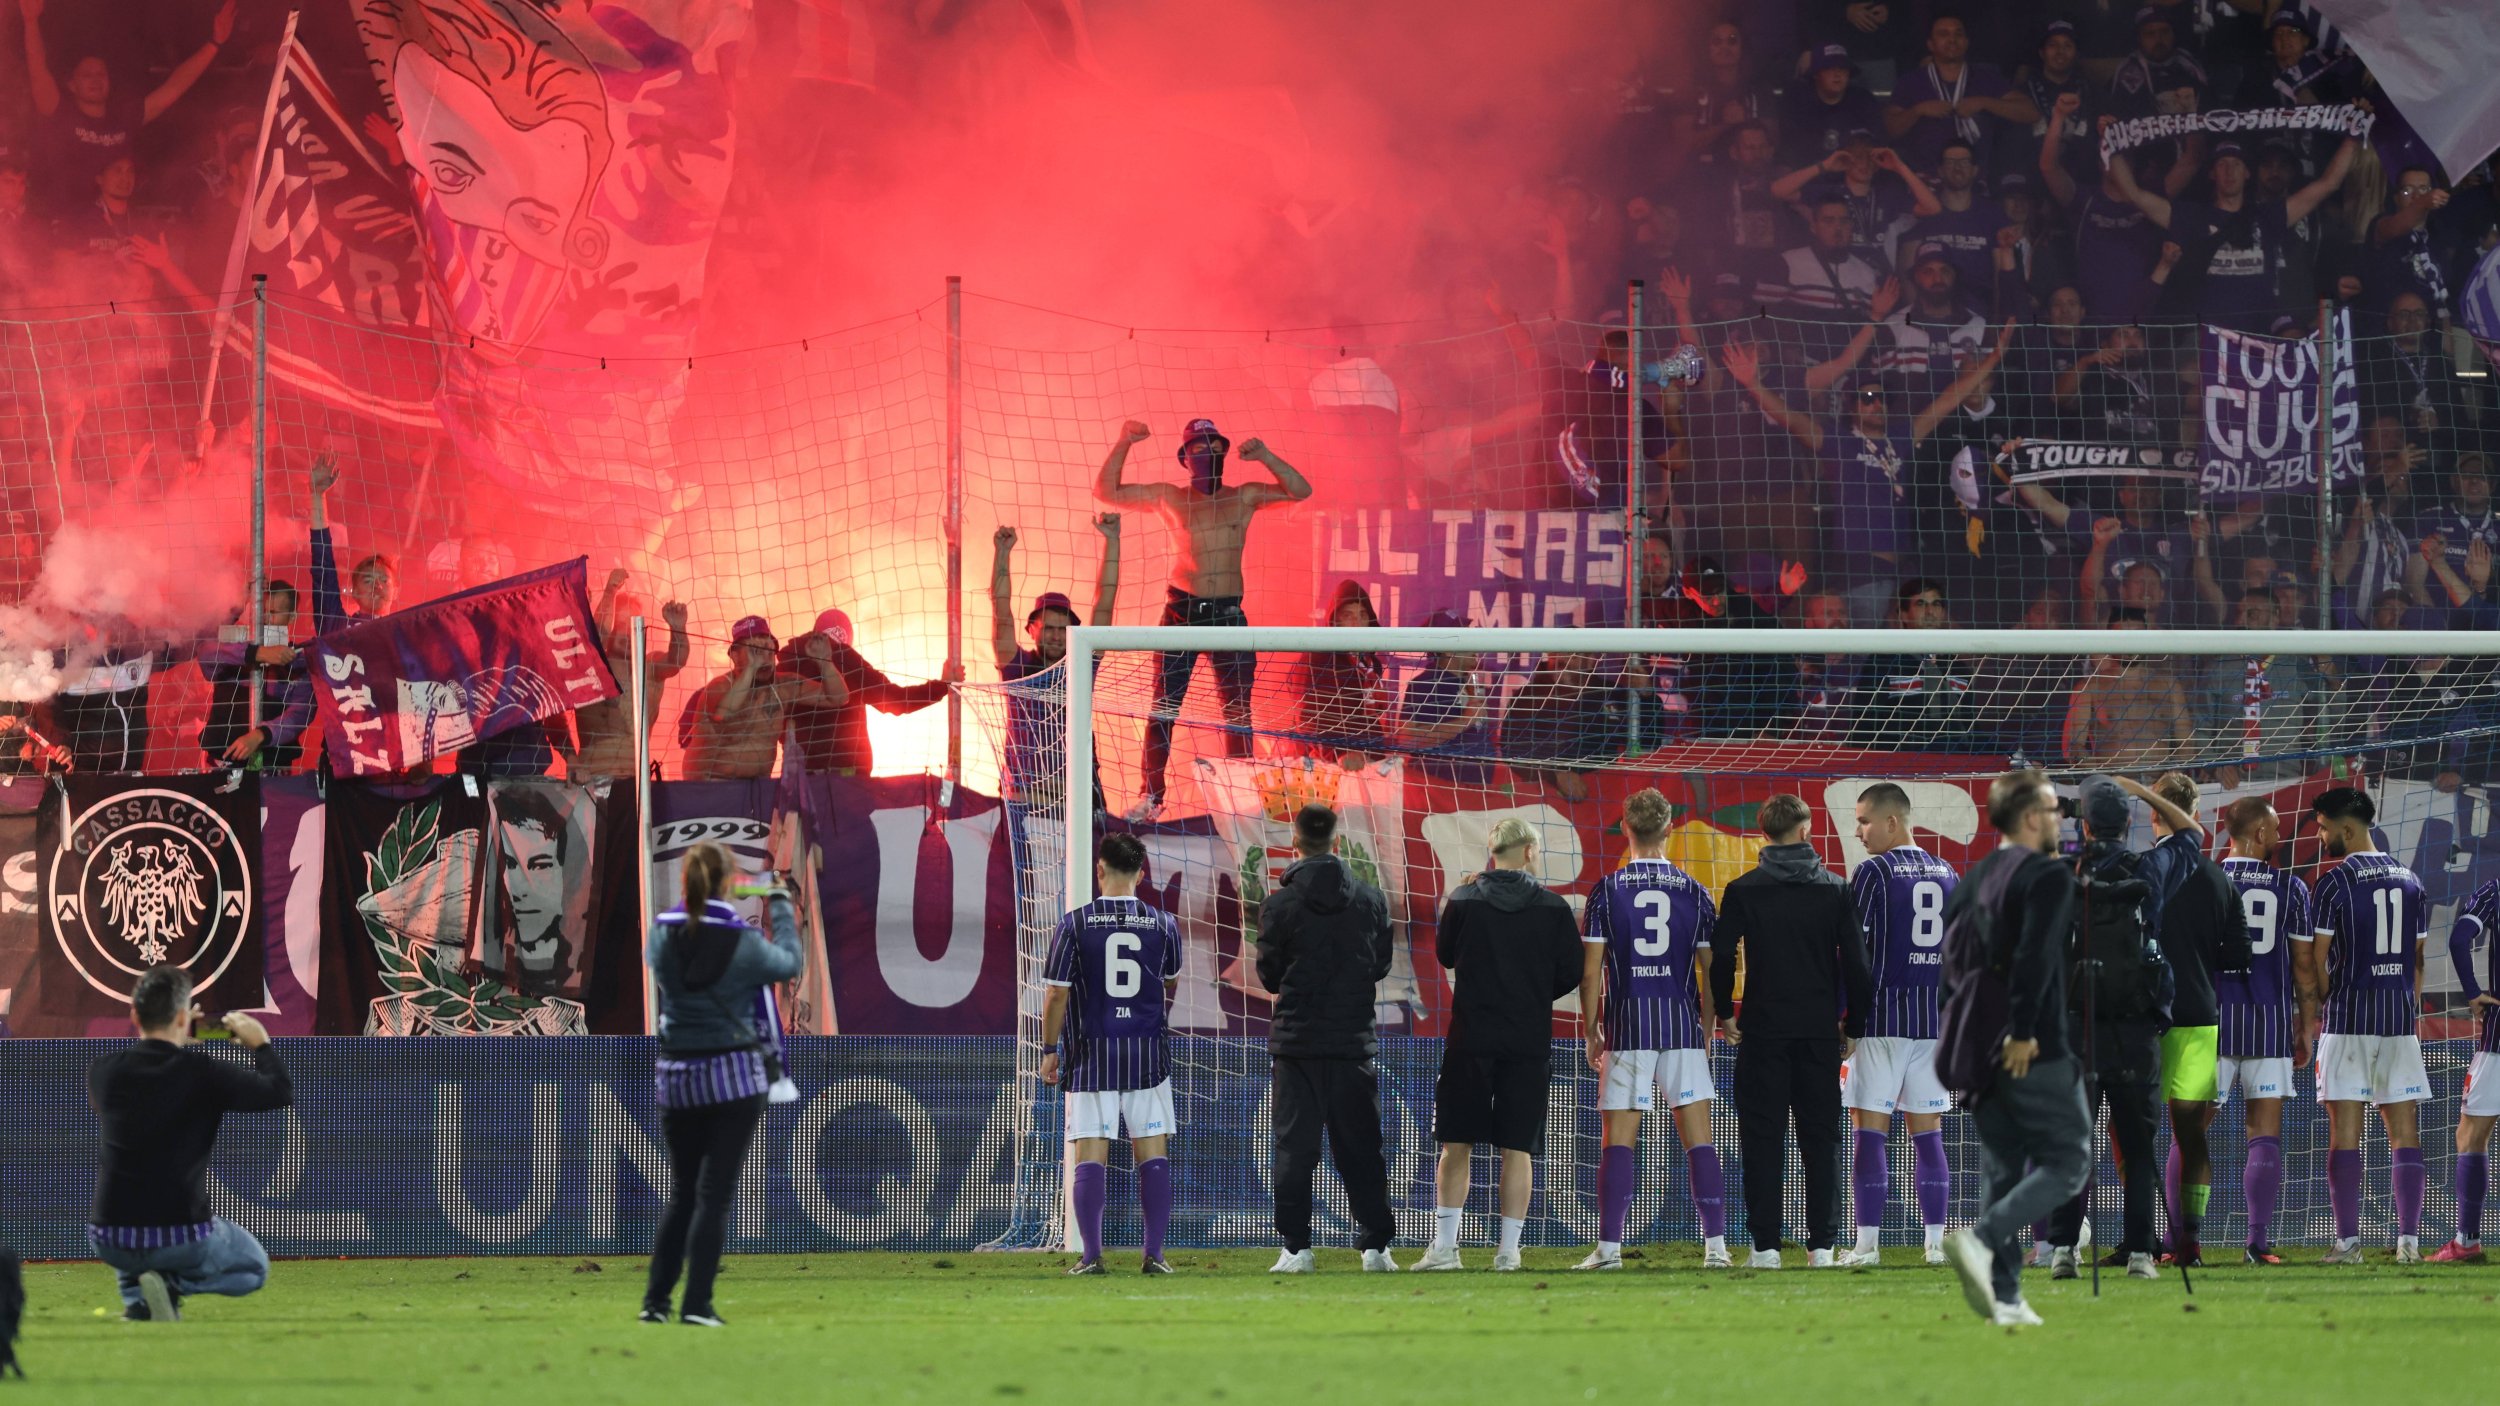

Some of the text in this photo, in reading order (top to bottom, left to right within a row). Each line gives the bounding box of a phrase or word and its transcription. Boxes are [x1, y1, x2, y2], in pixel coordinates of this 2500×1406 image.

[2026, 446, 2130, 470] TOUGH
[1327, 507, 1624, 588] ULTRAS
[73, 798, 226, 856] CASSACCO
[657, 822, 771, 846] 1999
[1894, 865, 1918, 873] ROWA
[2357, 867, 2383, 878] ROWA
[2388, 866, 2411, 876] MOSER
[1619, 873, 1648, 882] ROWA
[1656, 873, 1687, 885] MOSER
[2241, 871, 2274, 881] MOSER
[1087, 914, 1116, 924] ROWA
[1124, 914, 1156, 925] MOSER
[1911, 881, 1944, 947] 8
[1633, 889, 1671, 957] 3
[2373, 888, 2403, 955] 11
[1105, 932, 1142, 998] 6
[1631, 965, 1671, 977] TRKULJA
[1115, 1007, 1131, 1018] ZIA
[2259, 1084, 2276, 1092] PKE
[2405, 1085, 2422, 1094] PKE
